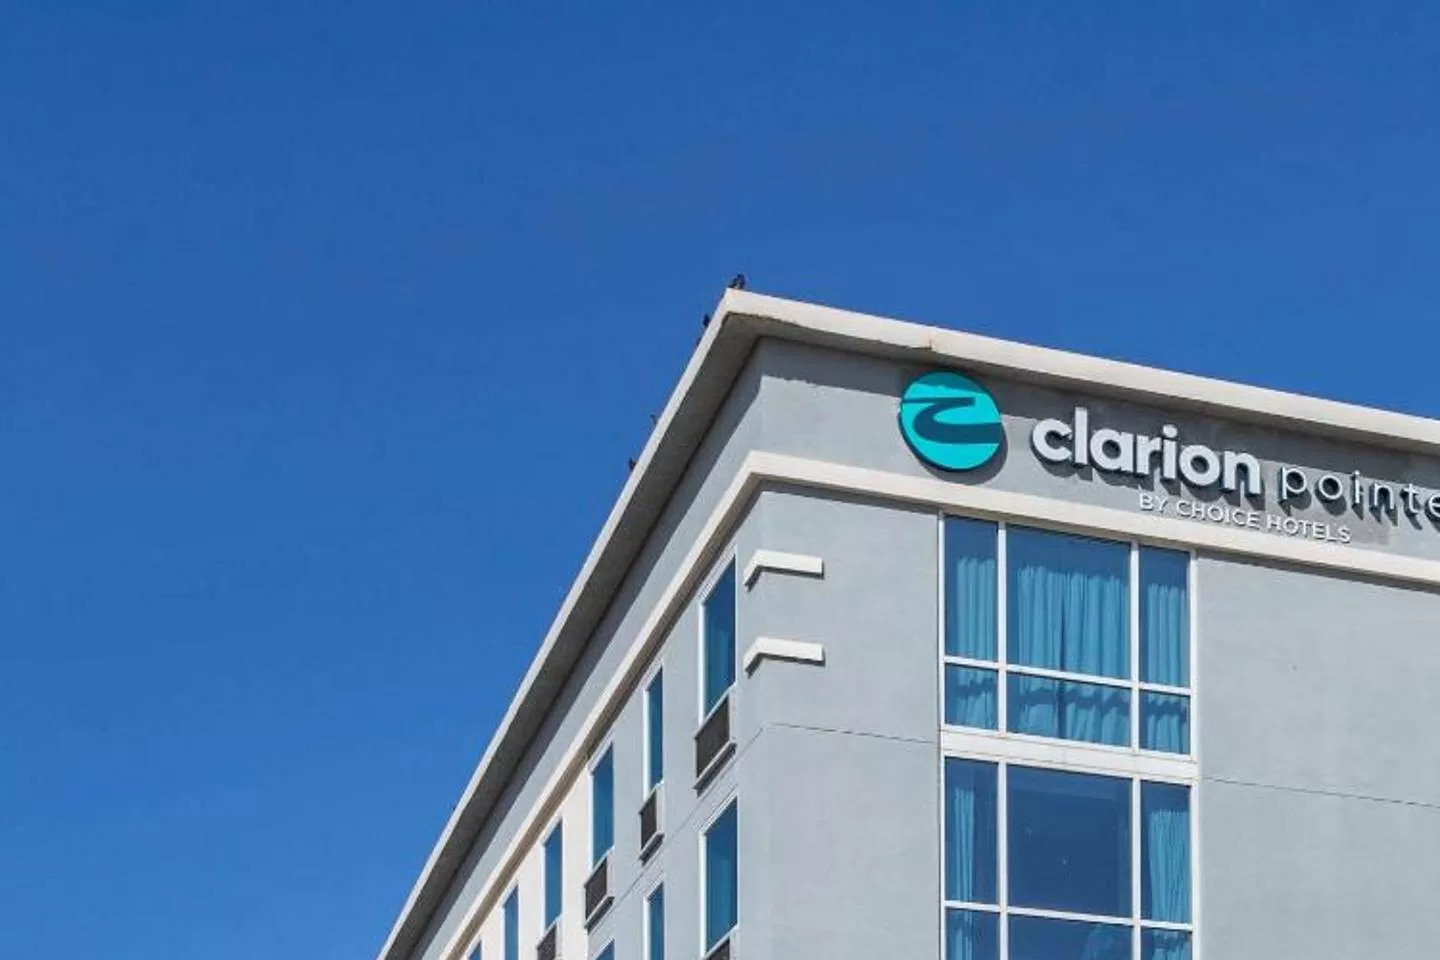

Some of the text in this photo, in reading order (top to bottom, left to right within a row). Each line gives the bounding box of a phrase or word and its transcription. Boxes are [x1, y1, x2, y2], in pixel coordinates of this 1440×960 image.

[1032, 406, 1260, 495] clarion
[1139, 492, 1351, 542] BY CHOICE HOTELS
